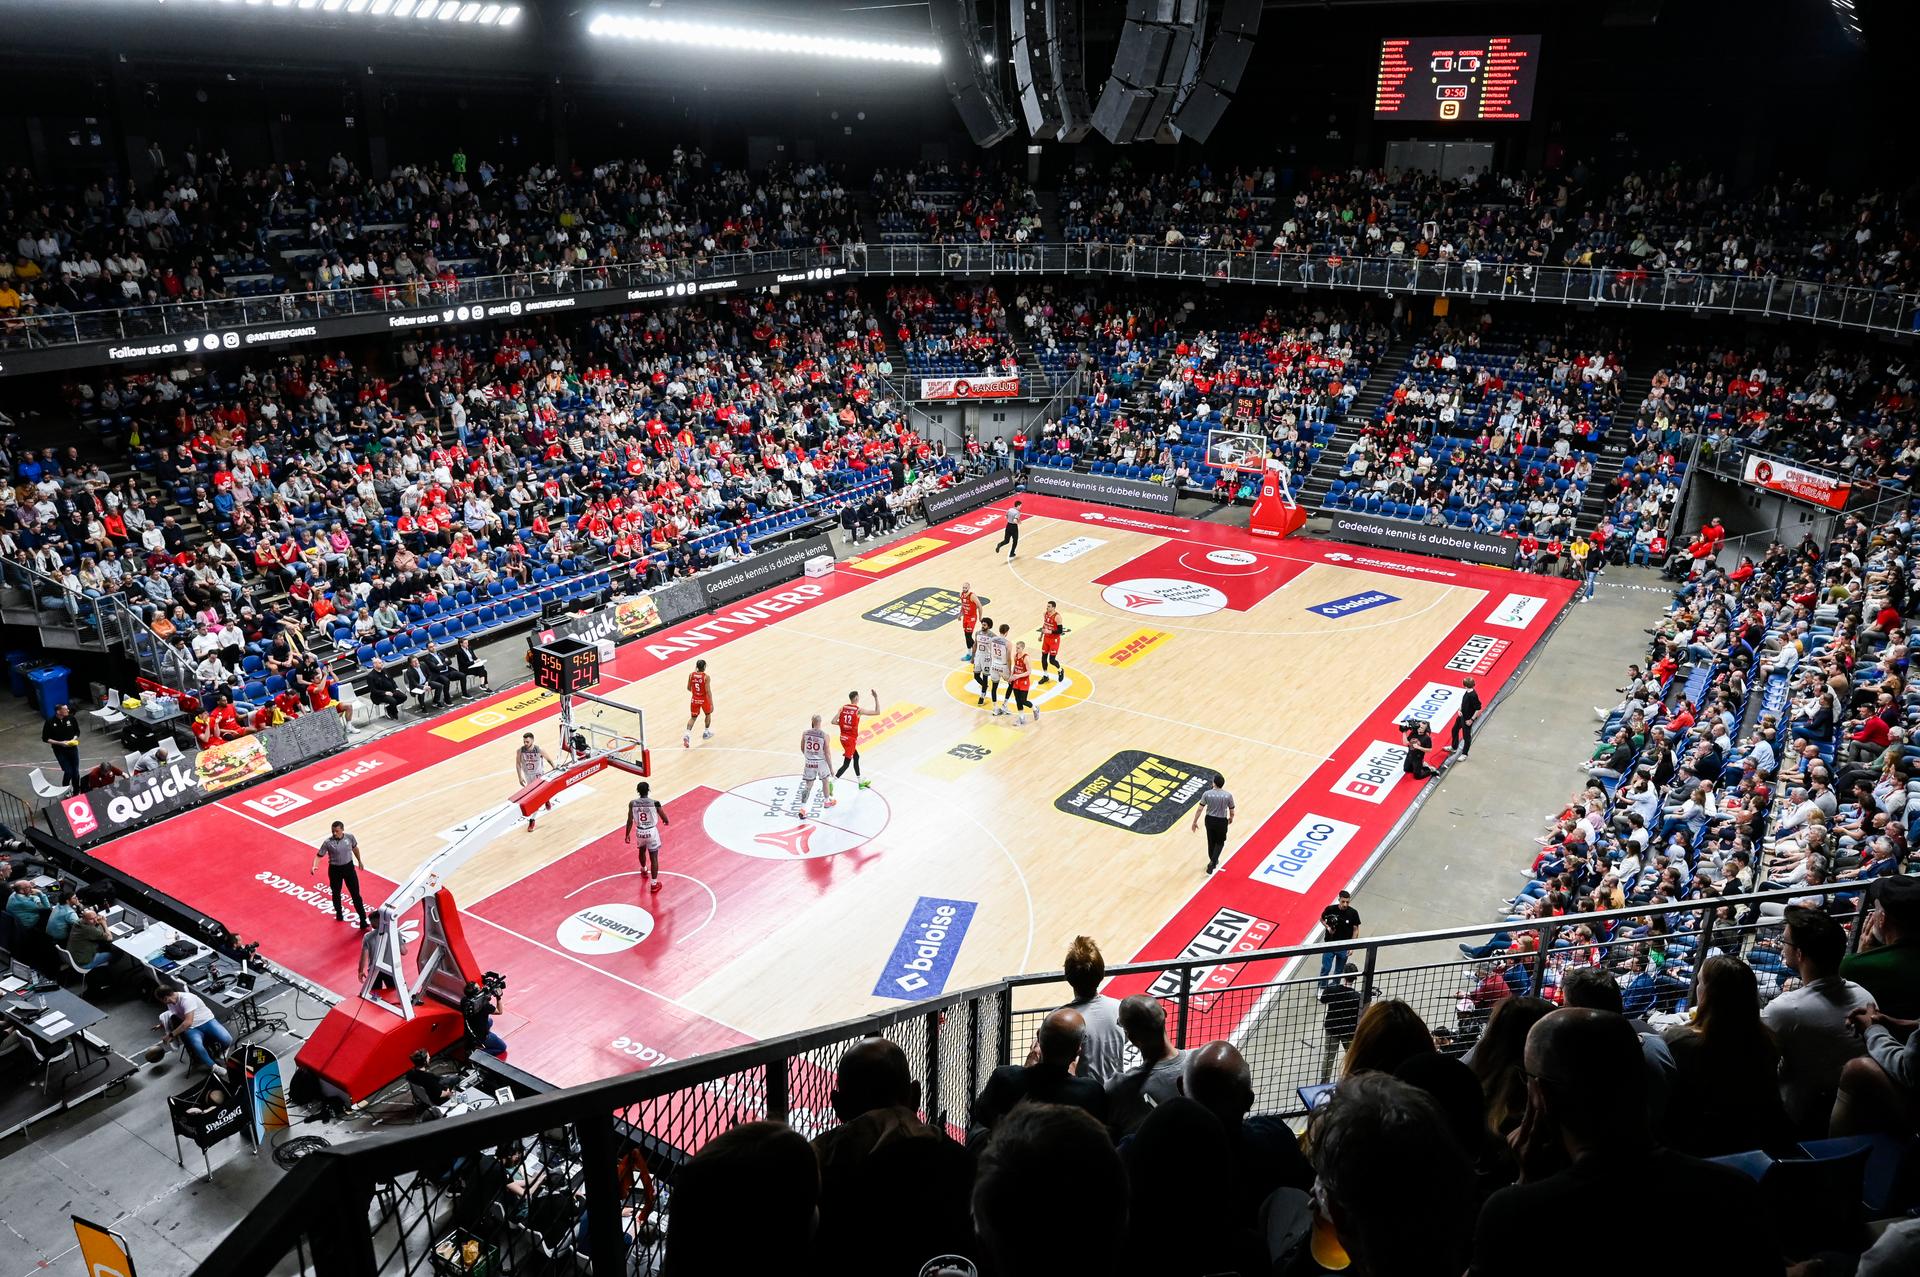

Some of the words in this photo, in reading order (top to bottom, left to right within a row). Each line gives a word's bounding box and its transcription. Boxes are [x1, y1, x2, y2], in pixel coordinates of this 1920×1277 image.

[1445, 89, 1465, 97] 9:56
[628, 291, 648, 300] Follow
[389, 316, 416, 326] Follow
[417, 316, 426, 324] us
[427, 314, 438, 322] on
[526, 298, 575, 312] @ANTWERPGIANTS
[109, 347, 146, 360] Follow
[148, 347, 162, 356] us
[162, 344, 177, 353] on
[246, 327, 317, 344] @ANTWERPGIANTS
[972, 382, 1017, 392] FANCLUB
[1236, 407, 1250, 417] 24
[1239, 398, 1252, 408] 9:56
[1034, 476, 1070, 488] Gedeelde
[1072, 480, 1097, 492] kennis
[1098, 484, 1105, 492] is
[1106, 485, 1141, 498] dubbele
[1142, 491, 1169, 502] kennis
[1780, 480, 1799, 492] ONE
[1799, 484, 1831, 502] DREAM
[1786, 470, 1804, 482] ONE
[1806, 475, 1830, 490] TEAM
[929, 497, 955, 512] Gedeelde
[954, 490, 970, 502] kennis
[975, 481, 994, 494] dubbele
[994, 476, 1010, 487] kennis
[974, 514, 1002, 526] Quick
[1338, 520, 1384, 535] Gedeelde
[1386, 527, 1416, 540] kennis
[1418, 532, 1426, 542] is
[1428, 534, 1471, 549] dubbele
[1473, 541, 1507, 555] kennis
[706, 573, 745, 594] Gedeelde
[744, 564, 769, 580] kennis
[769, 562, 776, 574] is
[776, 552, 806, 573] dubbele
[805, 543, 828, 556] kennis
[1154, 586, 1182, 595] Port
[1163, 588, 1210, 599] Antwerp
[1333, 594, 1388, 611] baloise
[644, 584, 824, 661] ANTWERP
[572, 652, 596, 666] 9:56
[1110, 635, 1159, 662] DHL
[1446, 635, 1494, 671] HEYLEN
[1472, 640, 1512, 674] VASTGOED
[542, 653, 562, 670] 9:56
[541, 668, 559, 690] 24
[572, 666, 592, 690] 24
[507, 692, 554, 711] telen
[844, 715, 852, 724] 12
[856, 711, 914, 746] DHL
[806, 742, 820, 750] 30
[312, 758, 385, 792] Quick
[1356, 747, 1408, 784] Belfius
[107, 764, 198, 823] Quick
[774, 786, 789, 797] of
[1066, 774, 1112, 808] betFIRST
[1085, 756, 1190, 827] BNXT
[1168, 775, 1208, 804] LEAGUE
[68, 801, 94, 824] Q
[640, 812, 648, 822] 8
[764, 798, 785, 817] Port
[1264, 824, 1335, 878] Talenco
[579, 911, 646, 940] LAURENTY
[904, 905, 957, 972] baloise
[1194, 922, 1271, 1006] VSTOED
[205, 1105, 243, 1134] SPALDING
